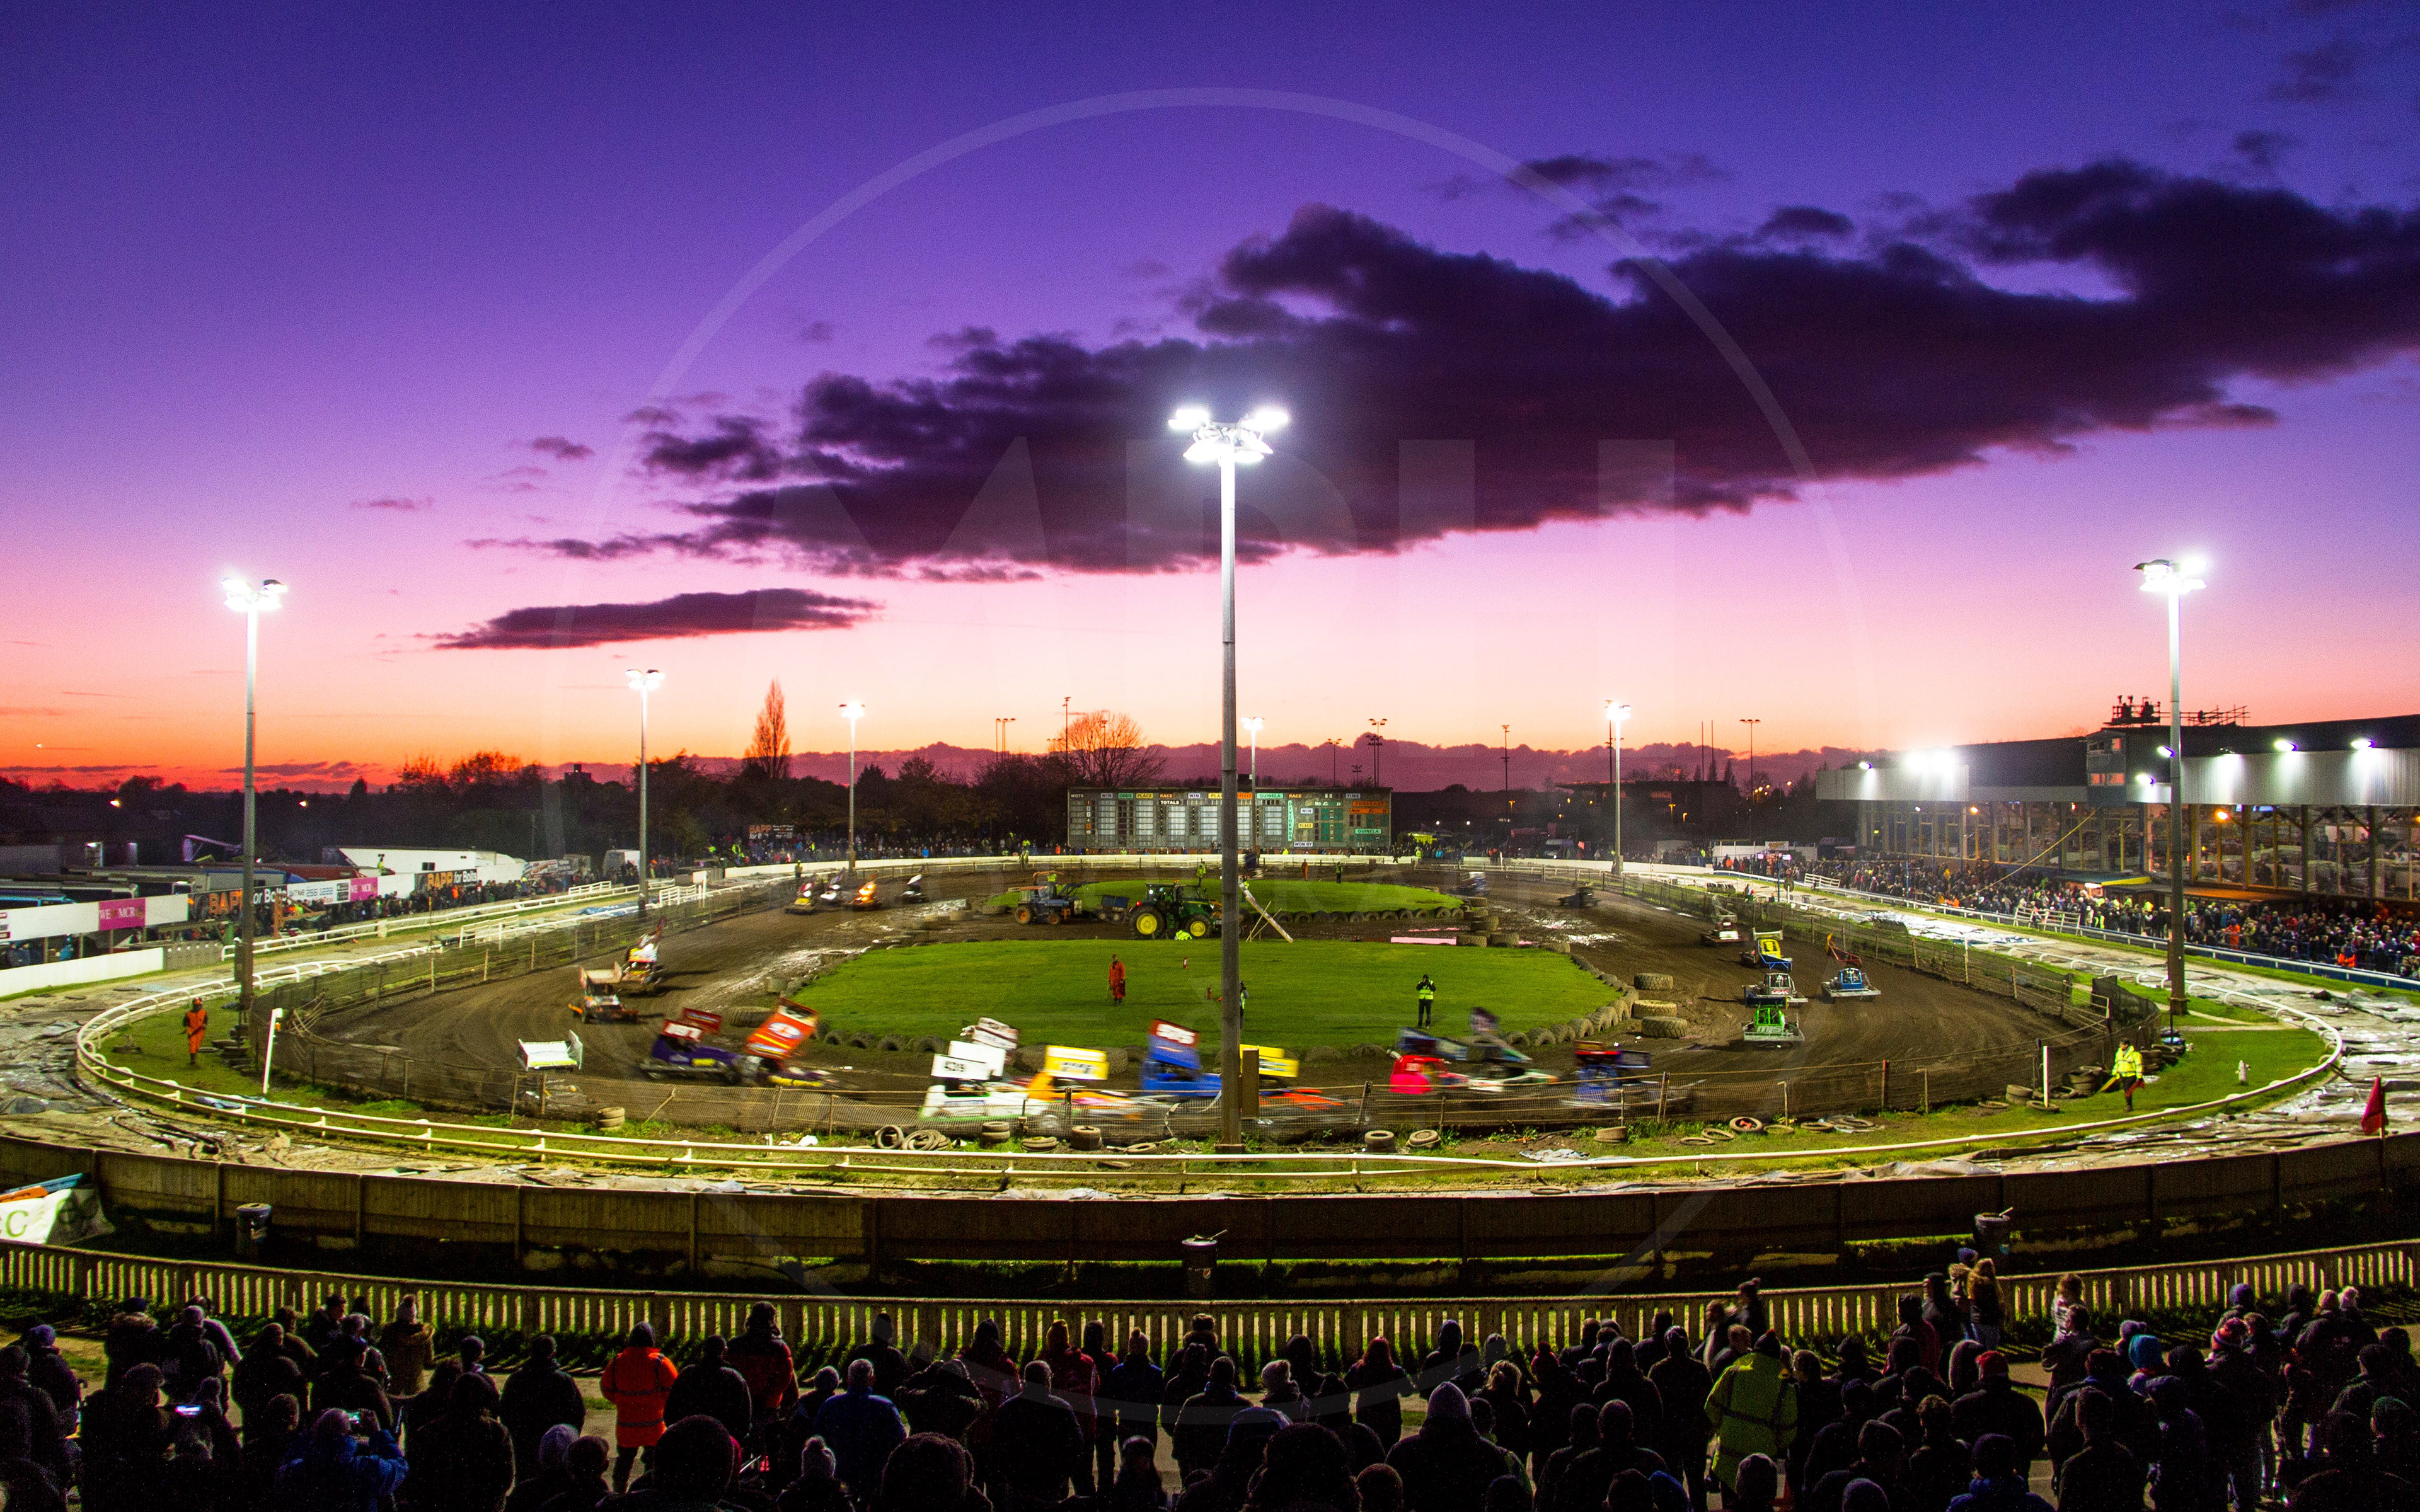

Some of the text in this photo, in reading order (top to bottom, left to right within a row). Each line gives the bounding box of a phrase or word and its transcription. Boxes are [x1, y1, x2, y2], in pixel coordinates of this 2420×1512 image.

[454, 871, 462, 884] for
[463, 870, 477, 883] Bolts
[100, 907, 135, 920] WE MCR
